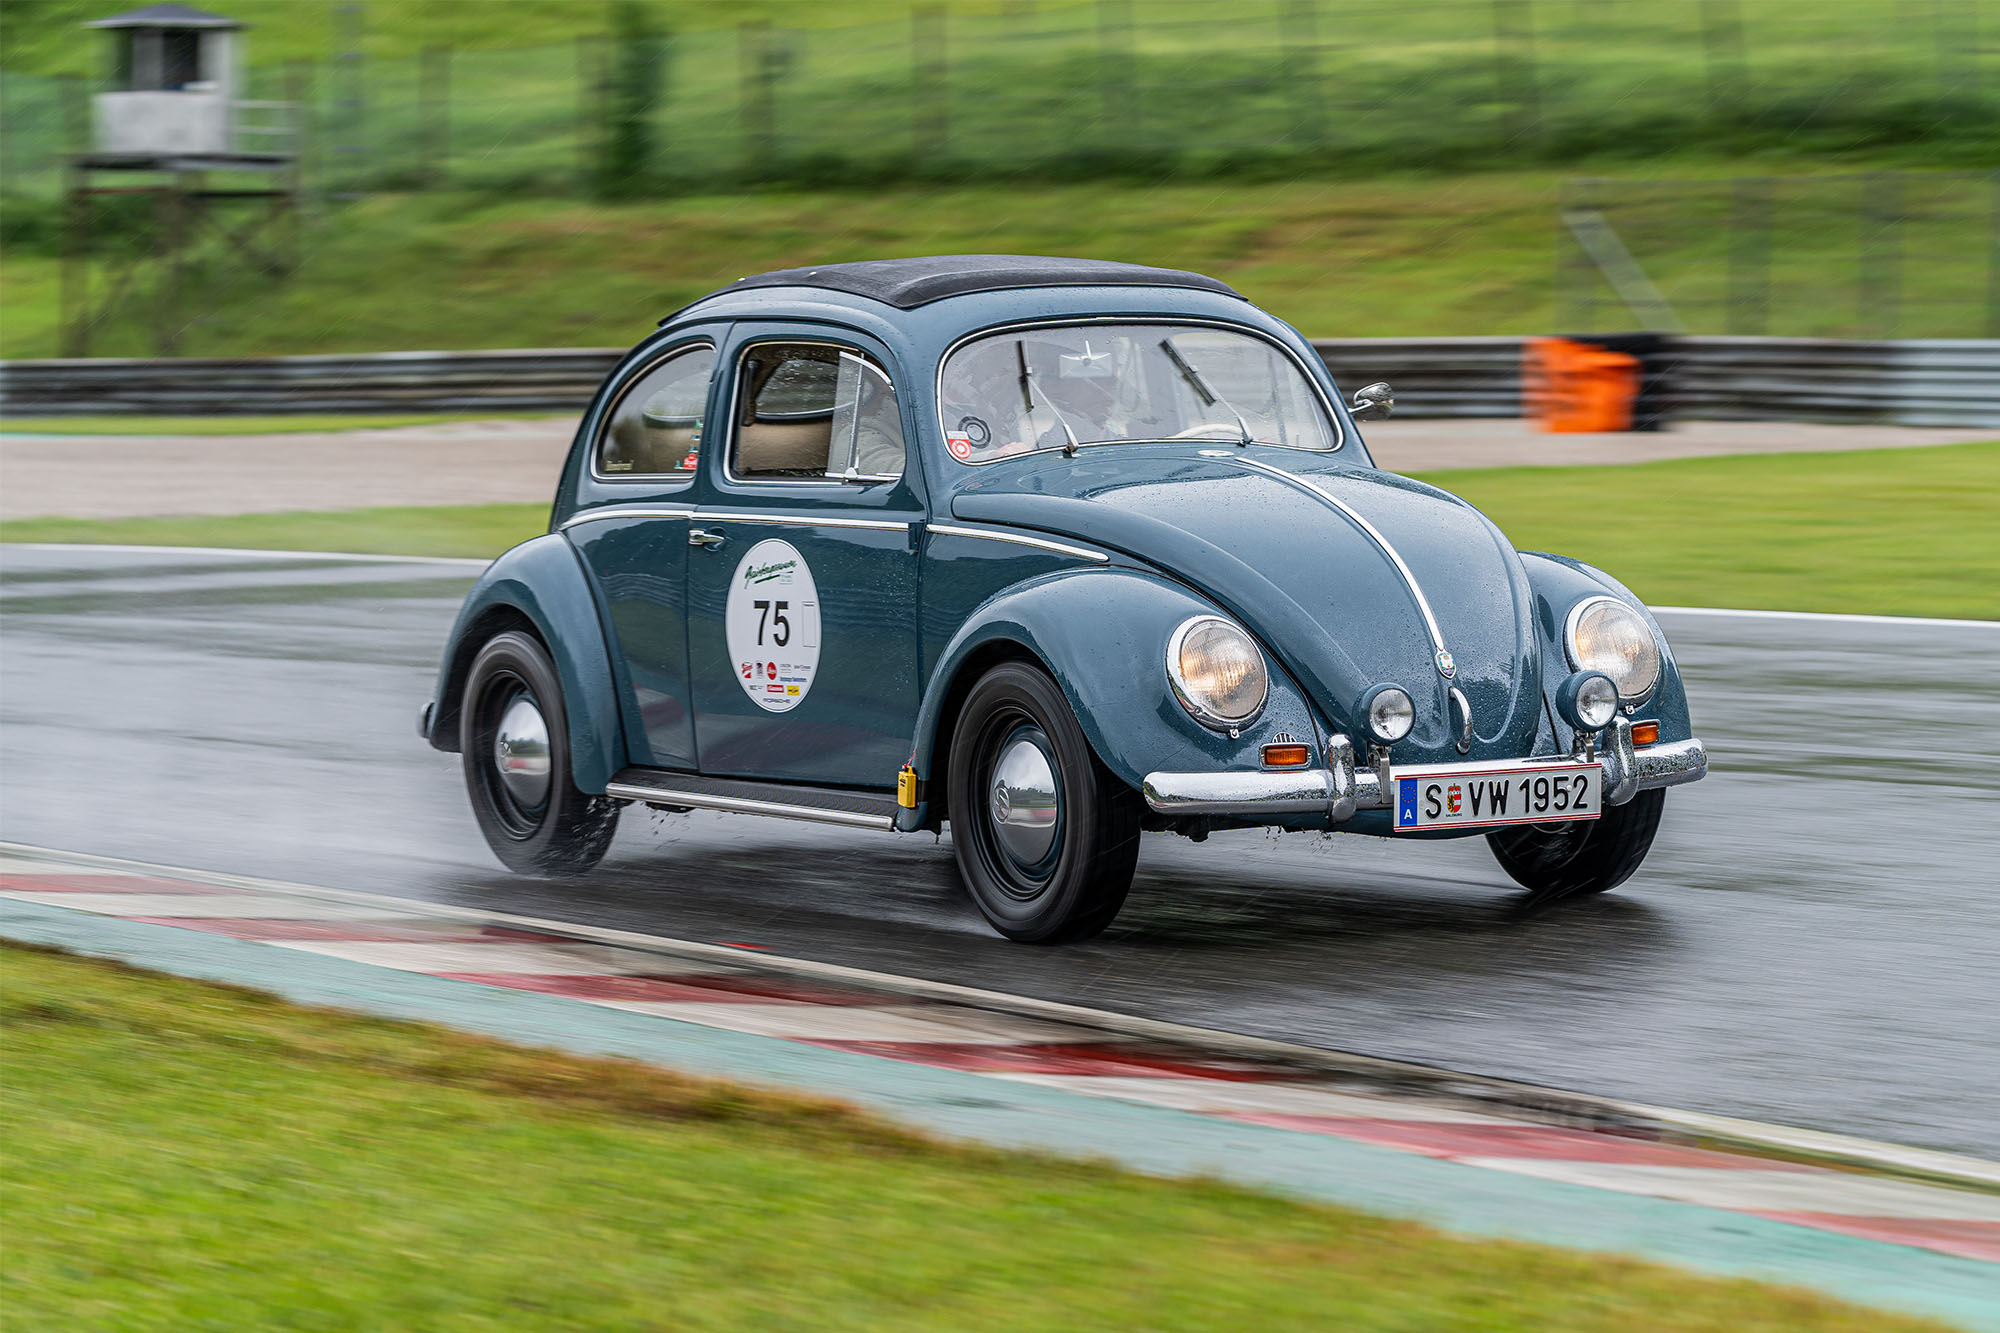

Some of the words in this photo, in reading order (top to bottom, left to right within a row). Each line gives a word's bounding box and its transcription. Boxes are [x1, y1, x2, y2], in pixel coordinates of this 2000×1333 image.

[753, 600, 790, 647] 75
[1403, 808, 1413, 820] A
[1425, 783, 1442, 819] S
[1468, 779, 1509, 817] VW
[1519, 774, 1588, 813] 1952
